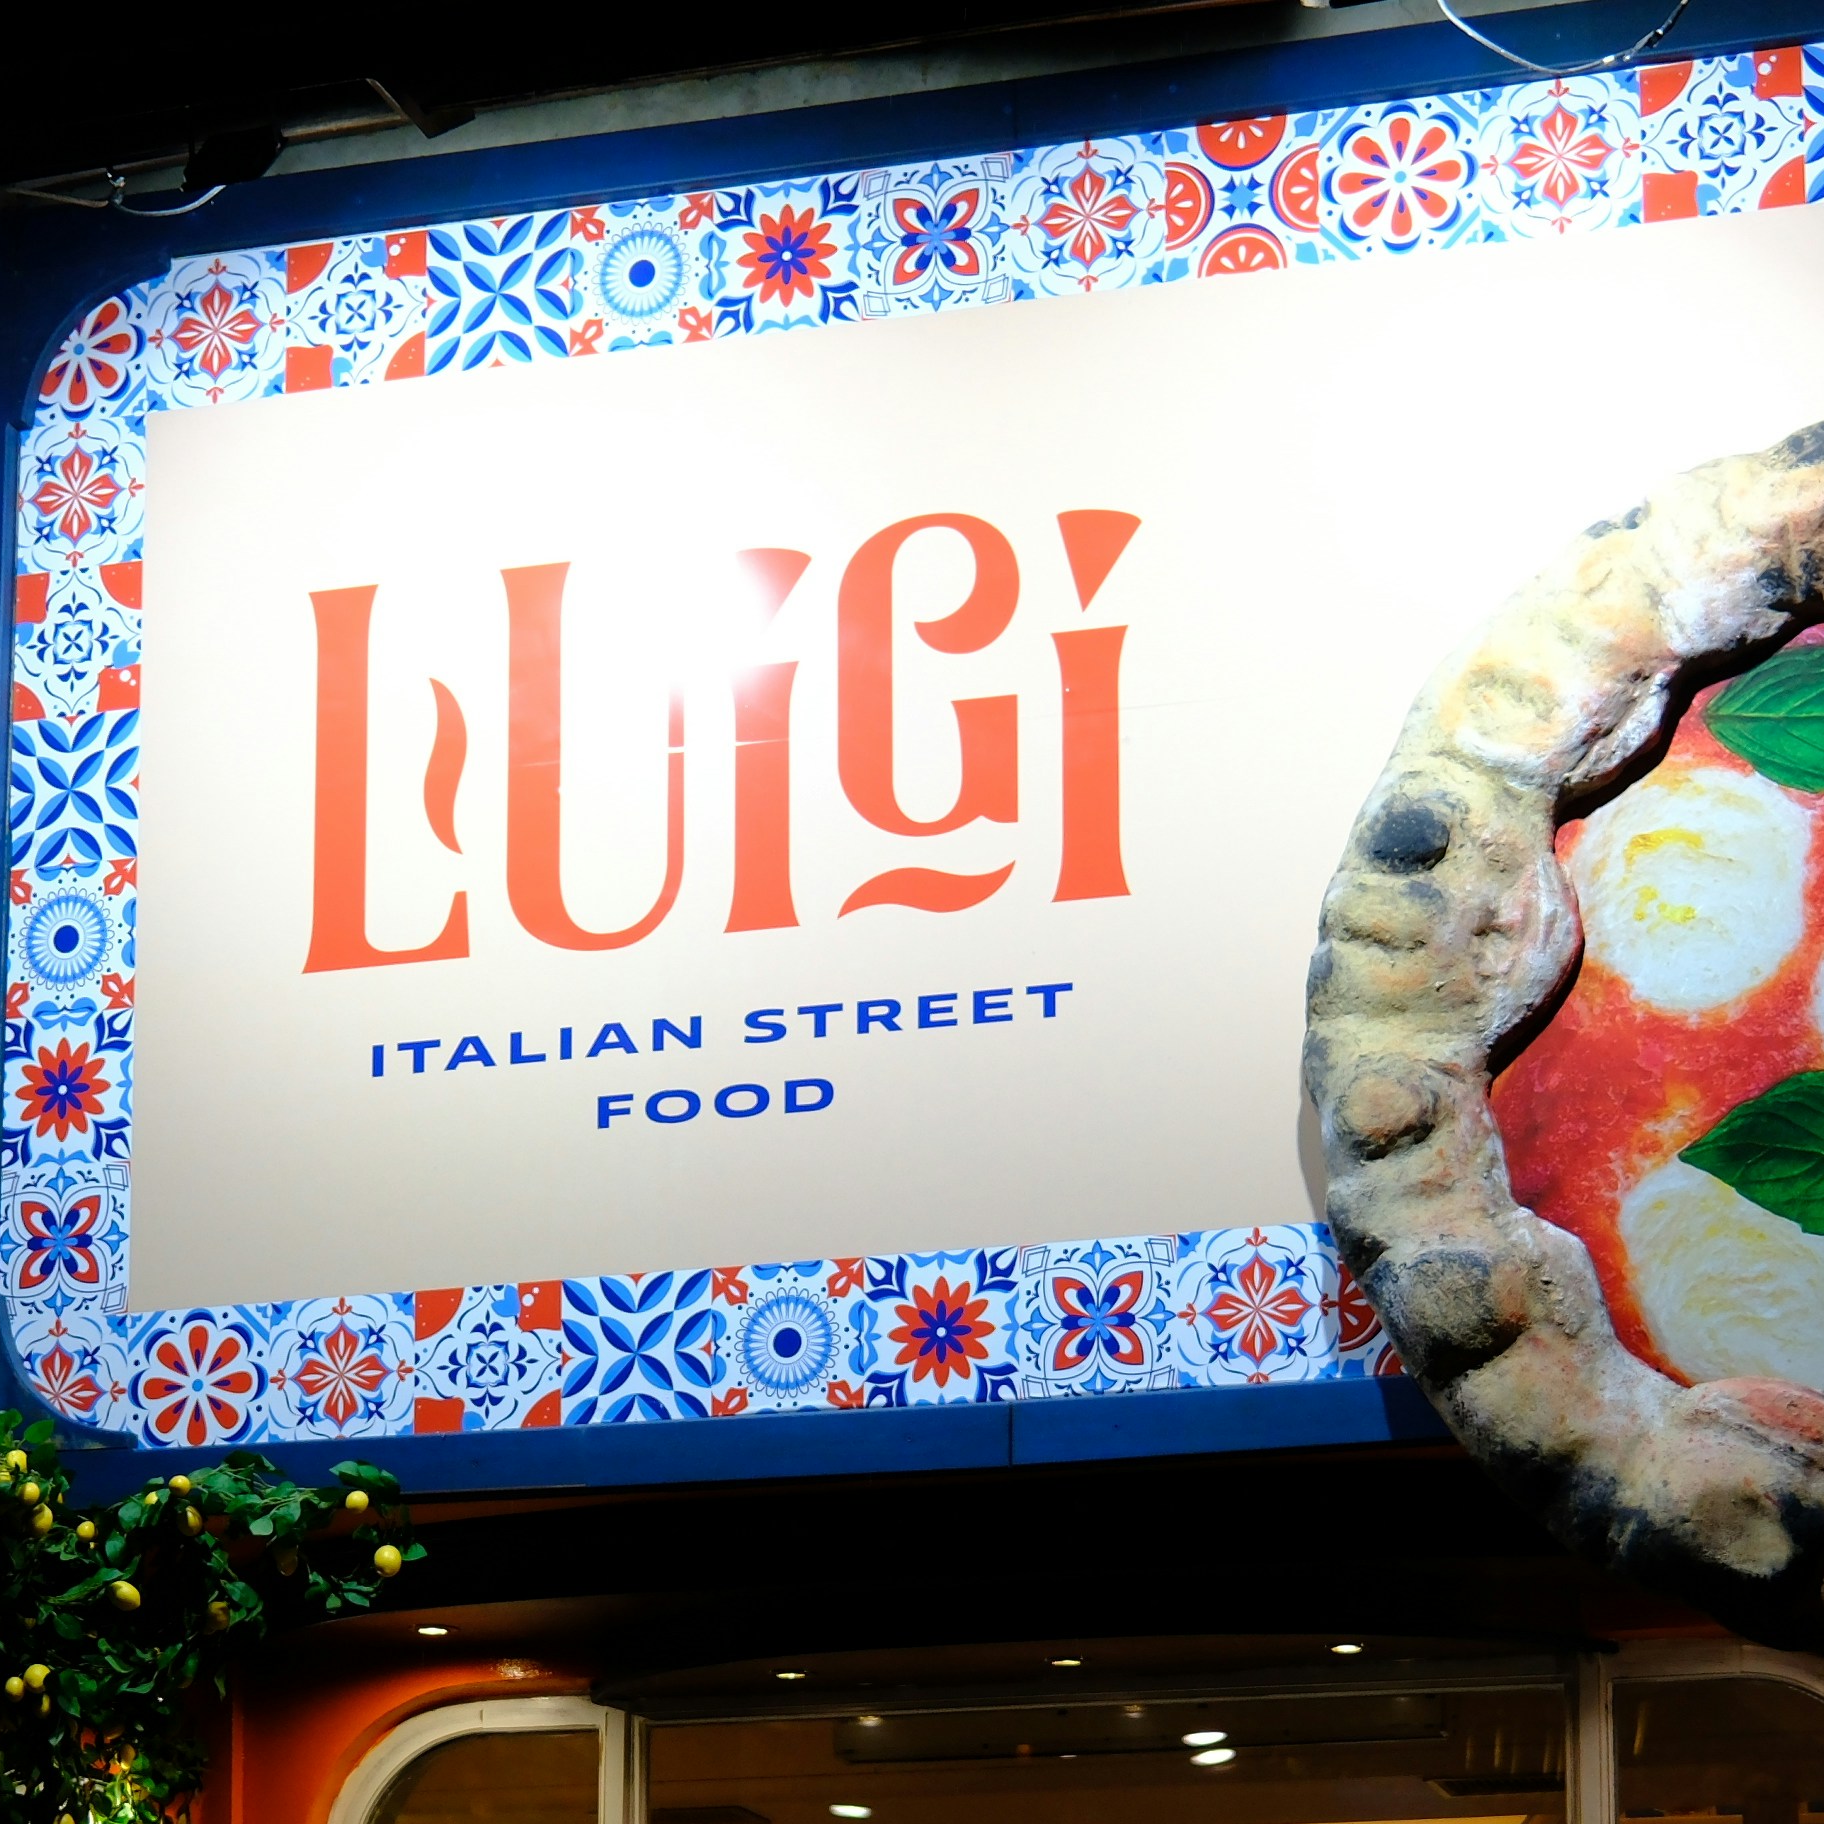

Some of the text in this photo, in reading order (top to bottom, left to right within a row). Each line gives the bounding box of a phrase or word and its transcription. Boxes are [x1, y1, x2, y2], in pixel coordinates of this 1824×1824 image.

[371, 981, 1075, 1078] ITALIAN STREET
[596, 1076, 836, 1129] FOOD
